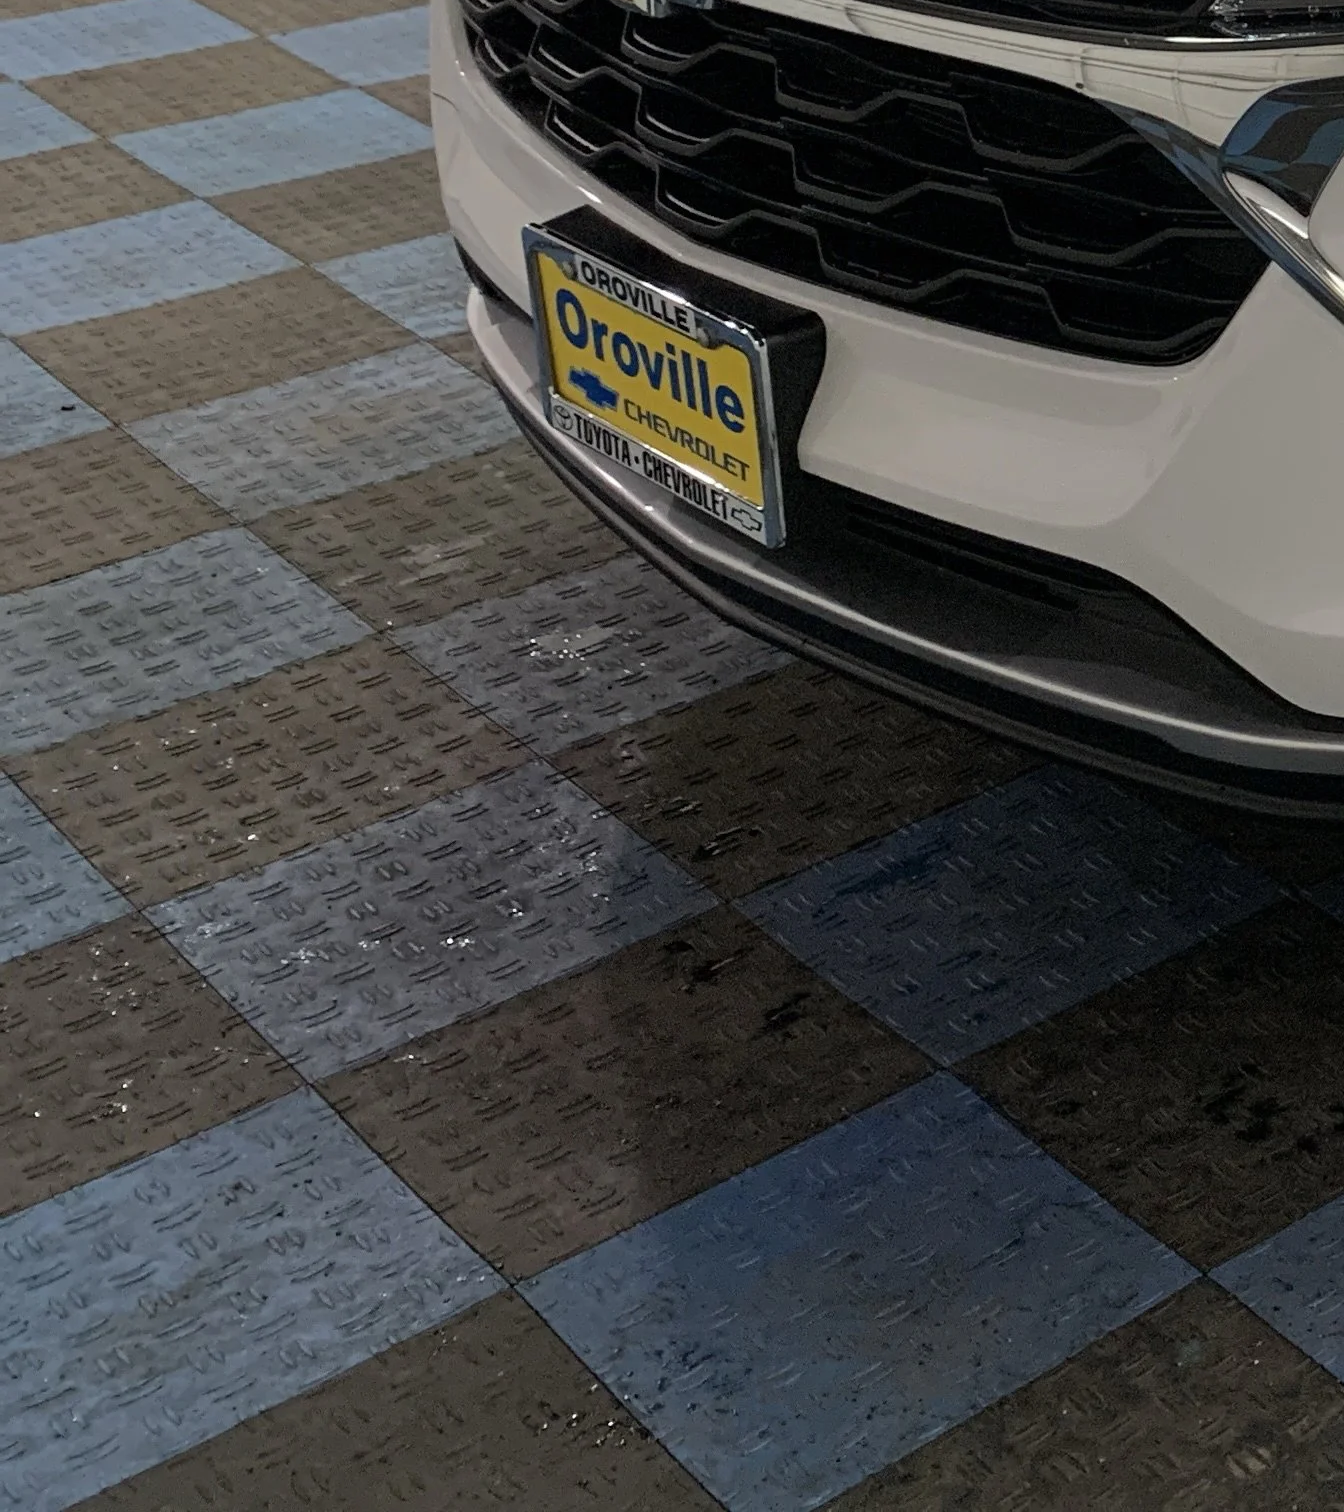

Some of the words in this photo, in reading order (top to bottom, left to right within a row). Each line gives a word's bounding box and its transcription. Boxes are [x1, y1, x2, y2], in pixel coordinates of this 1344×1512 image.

[580, 261, 690, 334] OROVILLE
[556, 288, 745, 434] Oroville
[575, 413, 631, 468] TOYOTA
[642, 451, 729, 521] CHEVROLET
[624, 398, 751, 482] CHEVROLET
